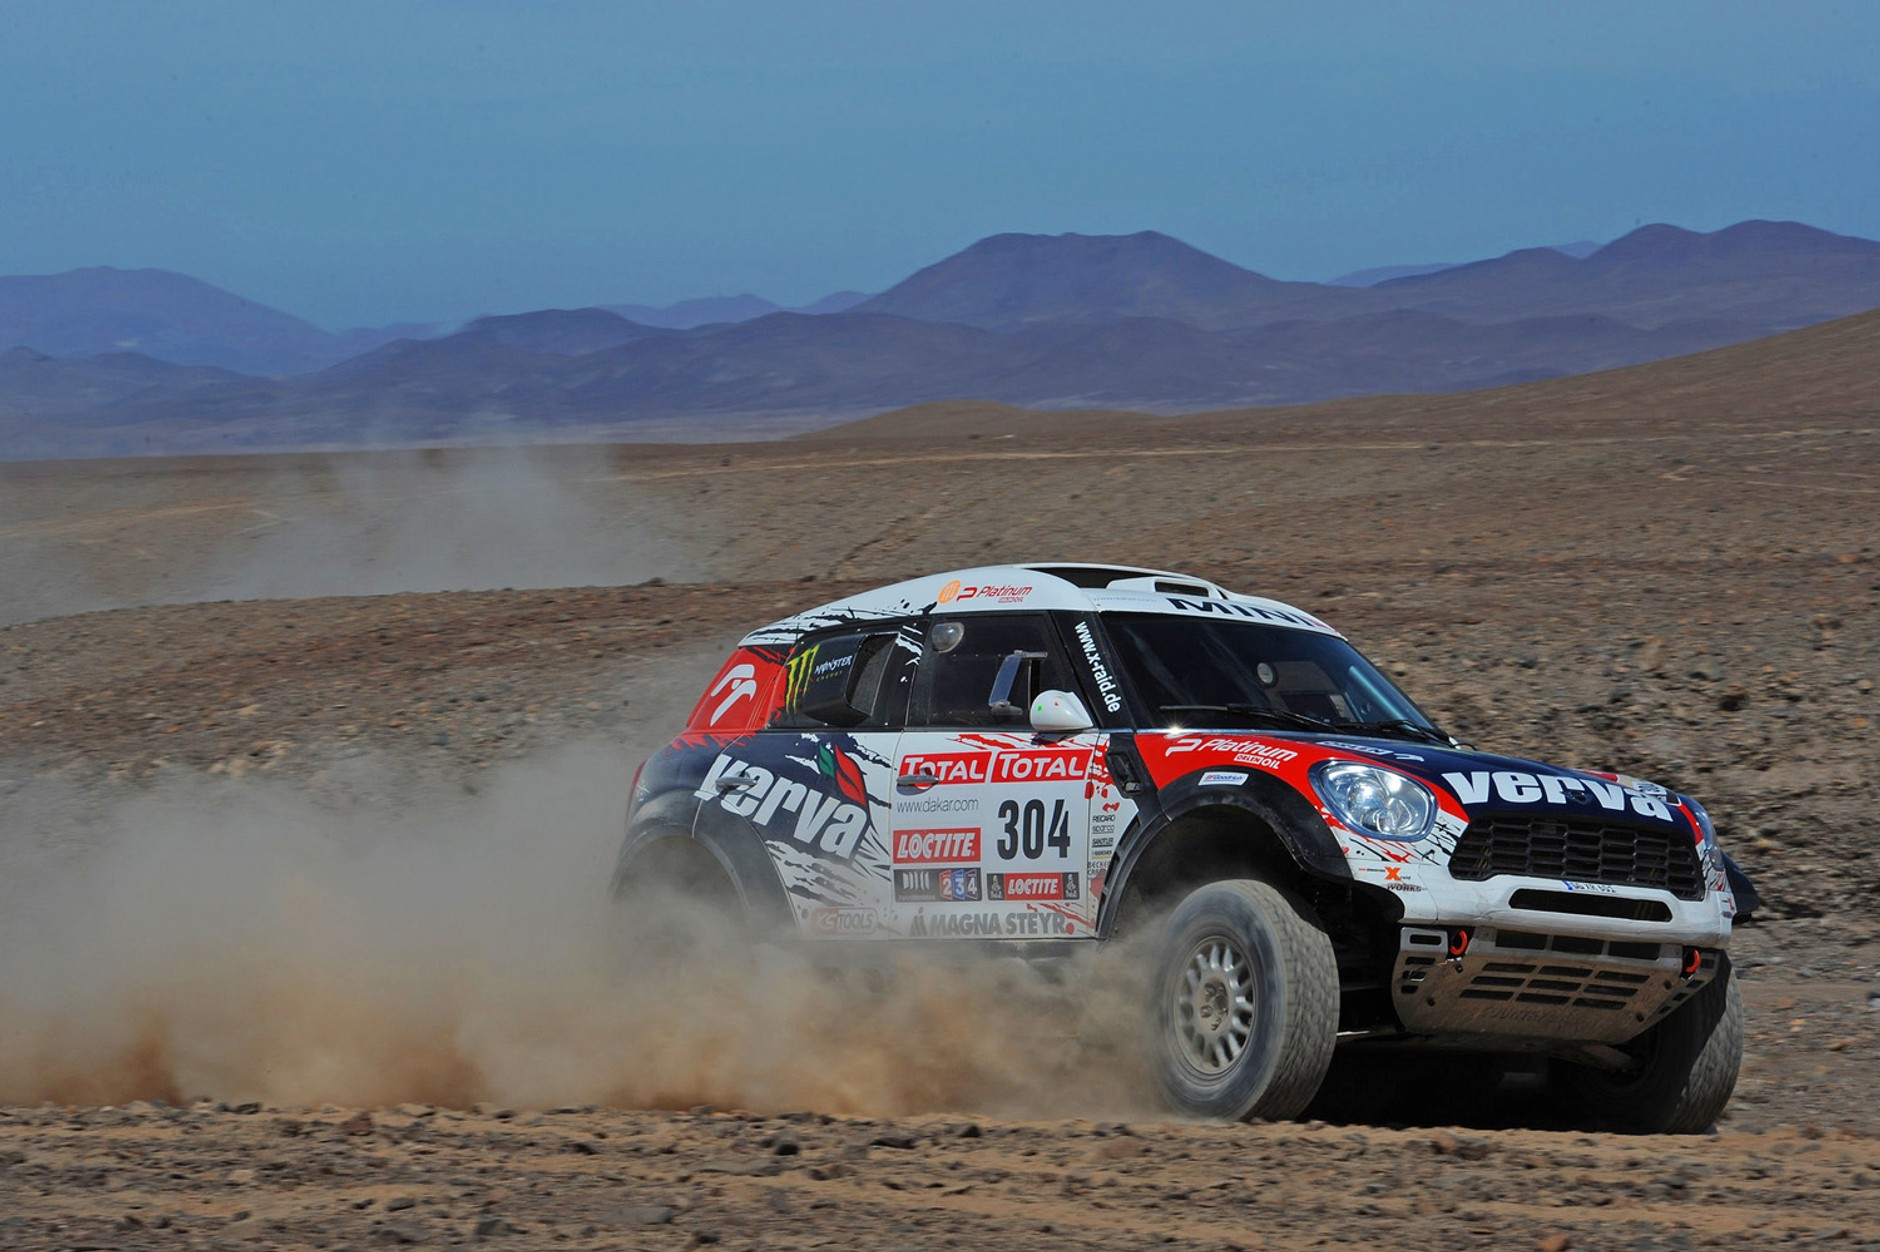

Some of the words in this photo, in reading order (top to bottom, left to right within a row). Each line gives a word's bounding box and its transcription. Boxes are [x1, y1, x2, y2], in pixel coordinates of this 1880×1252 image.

[976, 585, 1033, 598] Platinum
[1166, 597, 1315, 628] MINI
[814, 655, 853, 675] MONSTER
[1074, 621, 1121, 713] www.x-raid.de
[1197, 738, 1299, 762] Platinum
[1000, 753, 1084, 780] TOTAL
[1260, 758, 1281, 769] OIL
[896, 797, 979, 813] www.dakar.com
[1442, 771, 1674, 822] verva
[997, 799, 1071, 861] 304
[897, 832, 976, 859] LOCTITE
[1007, 878, 1060, 895] LOCTITE
[1387, 883, 1423, 892] WORKS
[929, 912, 1003, 936] MAGNA
[1005, 912, 1068, 936] STEYR
